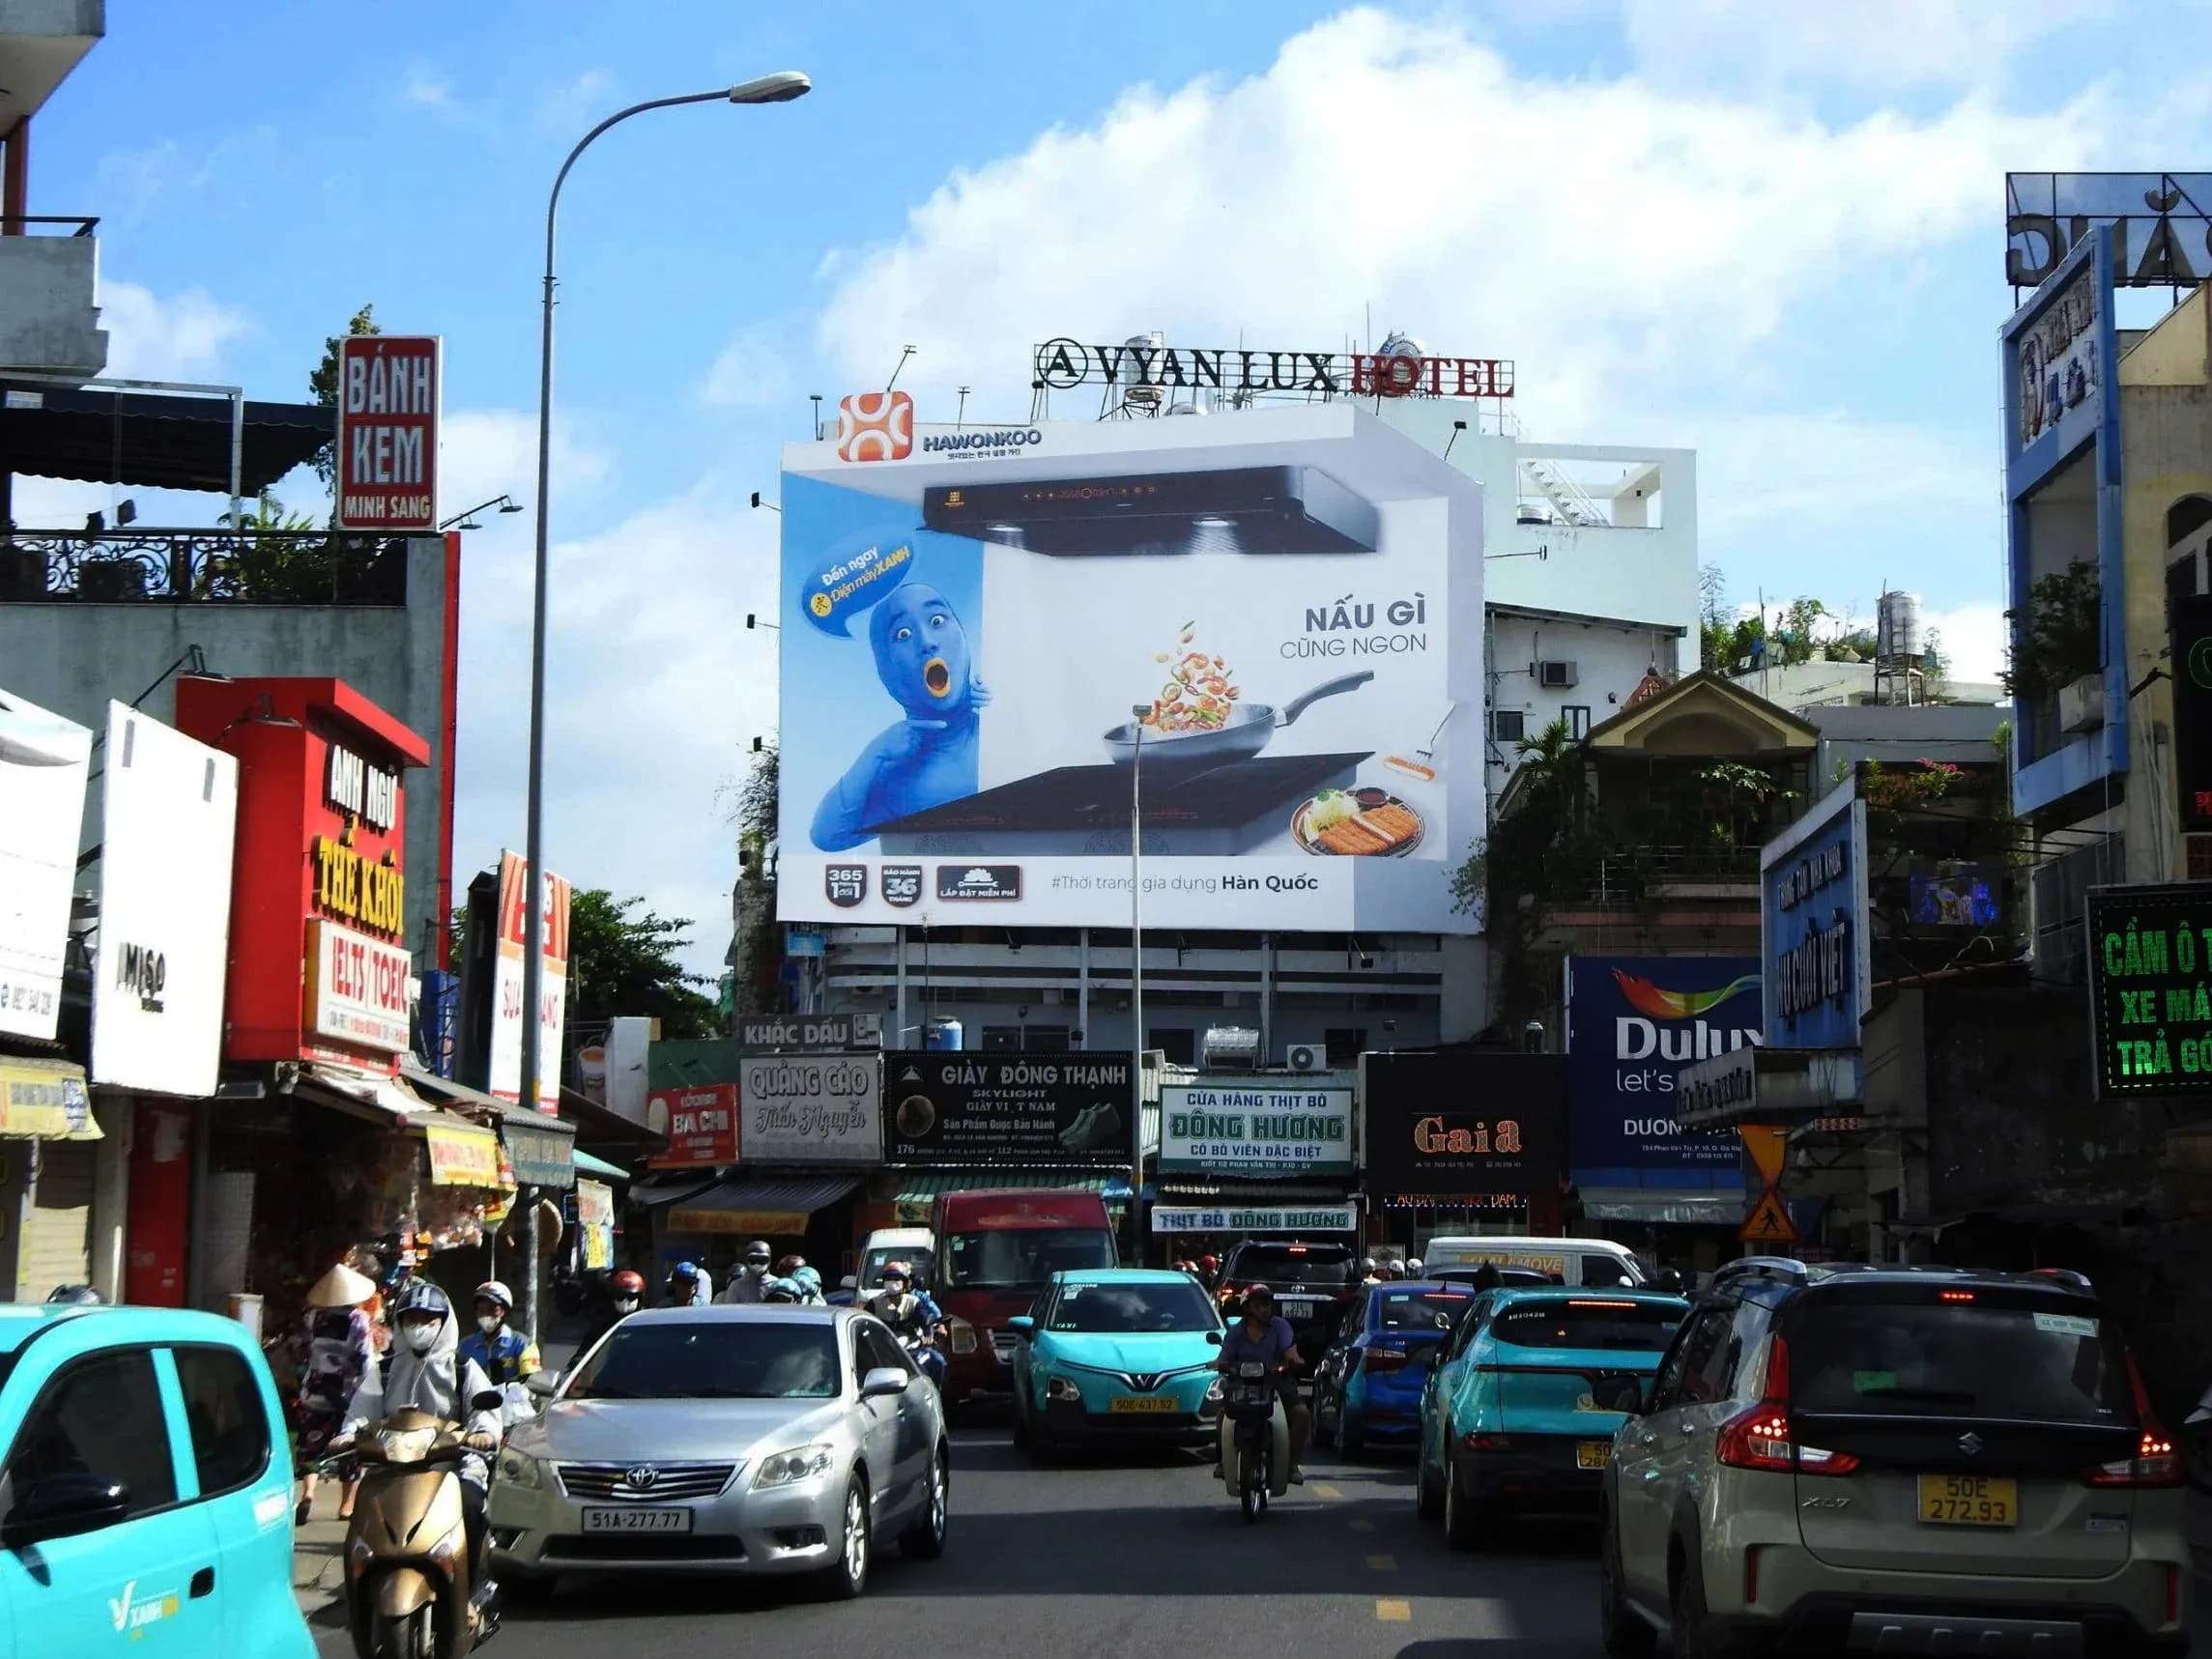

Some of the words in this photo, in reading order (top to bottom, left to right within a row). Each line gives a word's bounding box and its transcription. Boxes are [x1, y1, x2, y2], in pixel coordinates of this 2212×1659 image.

[348, 342, 431, 416] BÁNH
[1238, 351, 1338, 392] LUX
[1351, 354, 1515, 397] HOTEL
[923, 429, 1042, 452] HAWONKOO
[352, 425, 425, 485] KEM
[344, 495, 387, 520] MINH
[389, 495, 431, 520] SANG
[821, 564, 847, 586] Đến
[848, 546, 878, 569] ngay
[1306, 593, 1374, 632] NẤU
[1387, 592, 1425, 626] GÌ
[1279, 638, 1345, 659] CŨNG
[1353, 633, 1426, 655] NGON
[330, 744, 363, 815] ANH
[828, 870, 863, 881] 365
[886, 877, 917, 895] 36
[1142, 876, 1166, 894] gia
[1171, 874, 1217, 894] dụng
[1222, 874, 1259, 890] Hàn
[1265, 872, 1318, 893] Quốc
[2105, 916, 2169, 976] CẦM
[2176, 920, 2196, 973] Ô
[332, 936, 364, 1003] IELTS
[372, 951, 409, 1015] TOEIC
[2120, 989, 2157, 1024] XE
[2166, 981, 2212, 1022] MÁ
[745, 1015, 799, 1044] KHẮC
[804, 1016, 847, 1044] DẤU
[2117, 1028, 2172, 1074] TRẢ
[750, 1059, 820, 1100] QUẢNG
[824, 1061, 869, 1096] CÁO
[941, 1059, 988, 1084] GIÀY
[1000, 1060, 1058, 1084] ĐÔNG
[1064, 1066, 1126, 1089] THẠNH
[1616, 1068, 1675, 1092] let's
[972, 1089, 1048, 1099] SKYLIGHT
[1028, 1101, 1056, 1111] NAM
[1187, 1092, 1217, 1106] CỬA
[1222, 1092, 1263, 1107] HÀNG
[1269, 1095, 1303, 1110] THỊT
[1307, 1093, 1327, 1107] BÒ
[799, 1100, 866, 1138] Nguyễn
[1168, 1107, 1245, 1141] ĐÔNG
[1250, 1113, 1345, 1142] HƯƠNG
[1624, 1118, 1685, 1136] DƯƠN
[1414, 1116, 1523, 1153] Gaia
[897, 1144, 915, 1155] 176
[1191, 1143, 1207, 1156] CÓ
[1212, 1143, 1227, 1156] BÒ
[1233, 1143, 1261, 1157] VIÊN
[1295, 1144, 1322, 1159] BIỆT
[1160, 1214, 1195, 1228] THỊT
[1201, 1212, 1223, 1228] BÒ
[1229, 1211, 1282, 1229] ĐÔNG
[1284, 1212, 1349, 1228] HƯƠNG
[1947, 1477, 1988, 1498] 50E
[592, 1512, 680, 1528] 51A-277.77
[1931, 1500, 2006, 1522] 272.93
